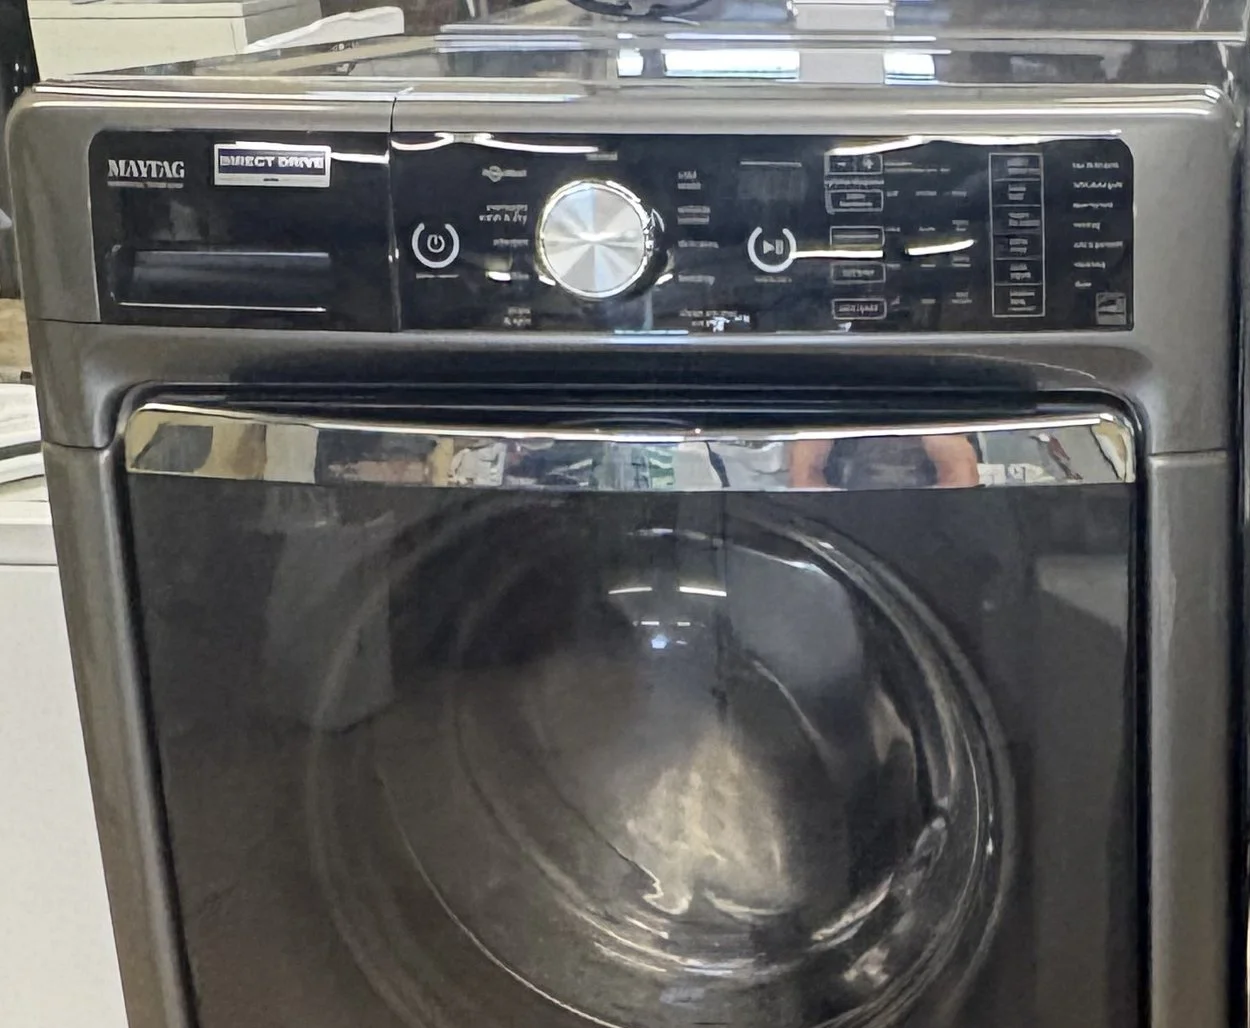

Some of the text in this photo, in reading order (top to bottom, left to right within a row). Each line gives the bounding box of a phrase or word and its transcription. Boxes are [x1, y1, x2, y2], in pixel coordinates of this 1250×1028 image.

[107, 159, 185, 178] MAYTAG
[219, 155, 325, 169] DIRECT DRIVE
